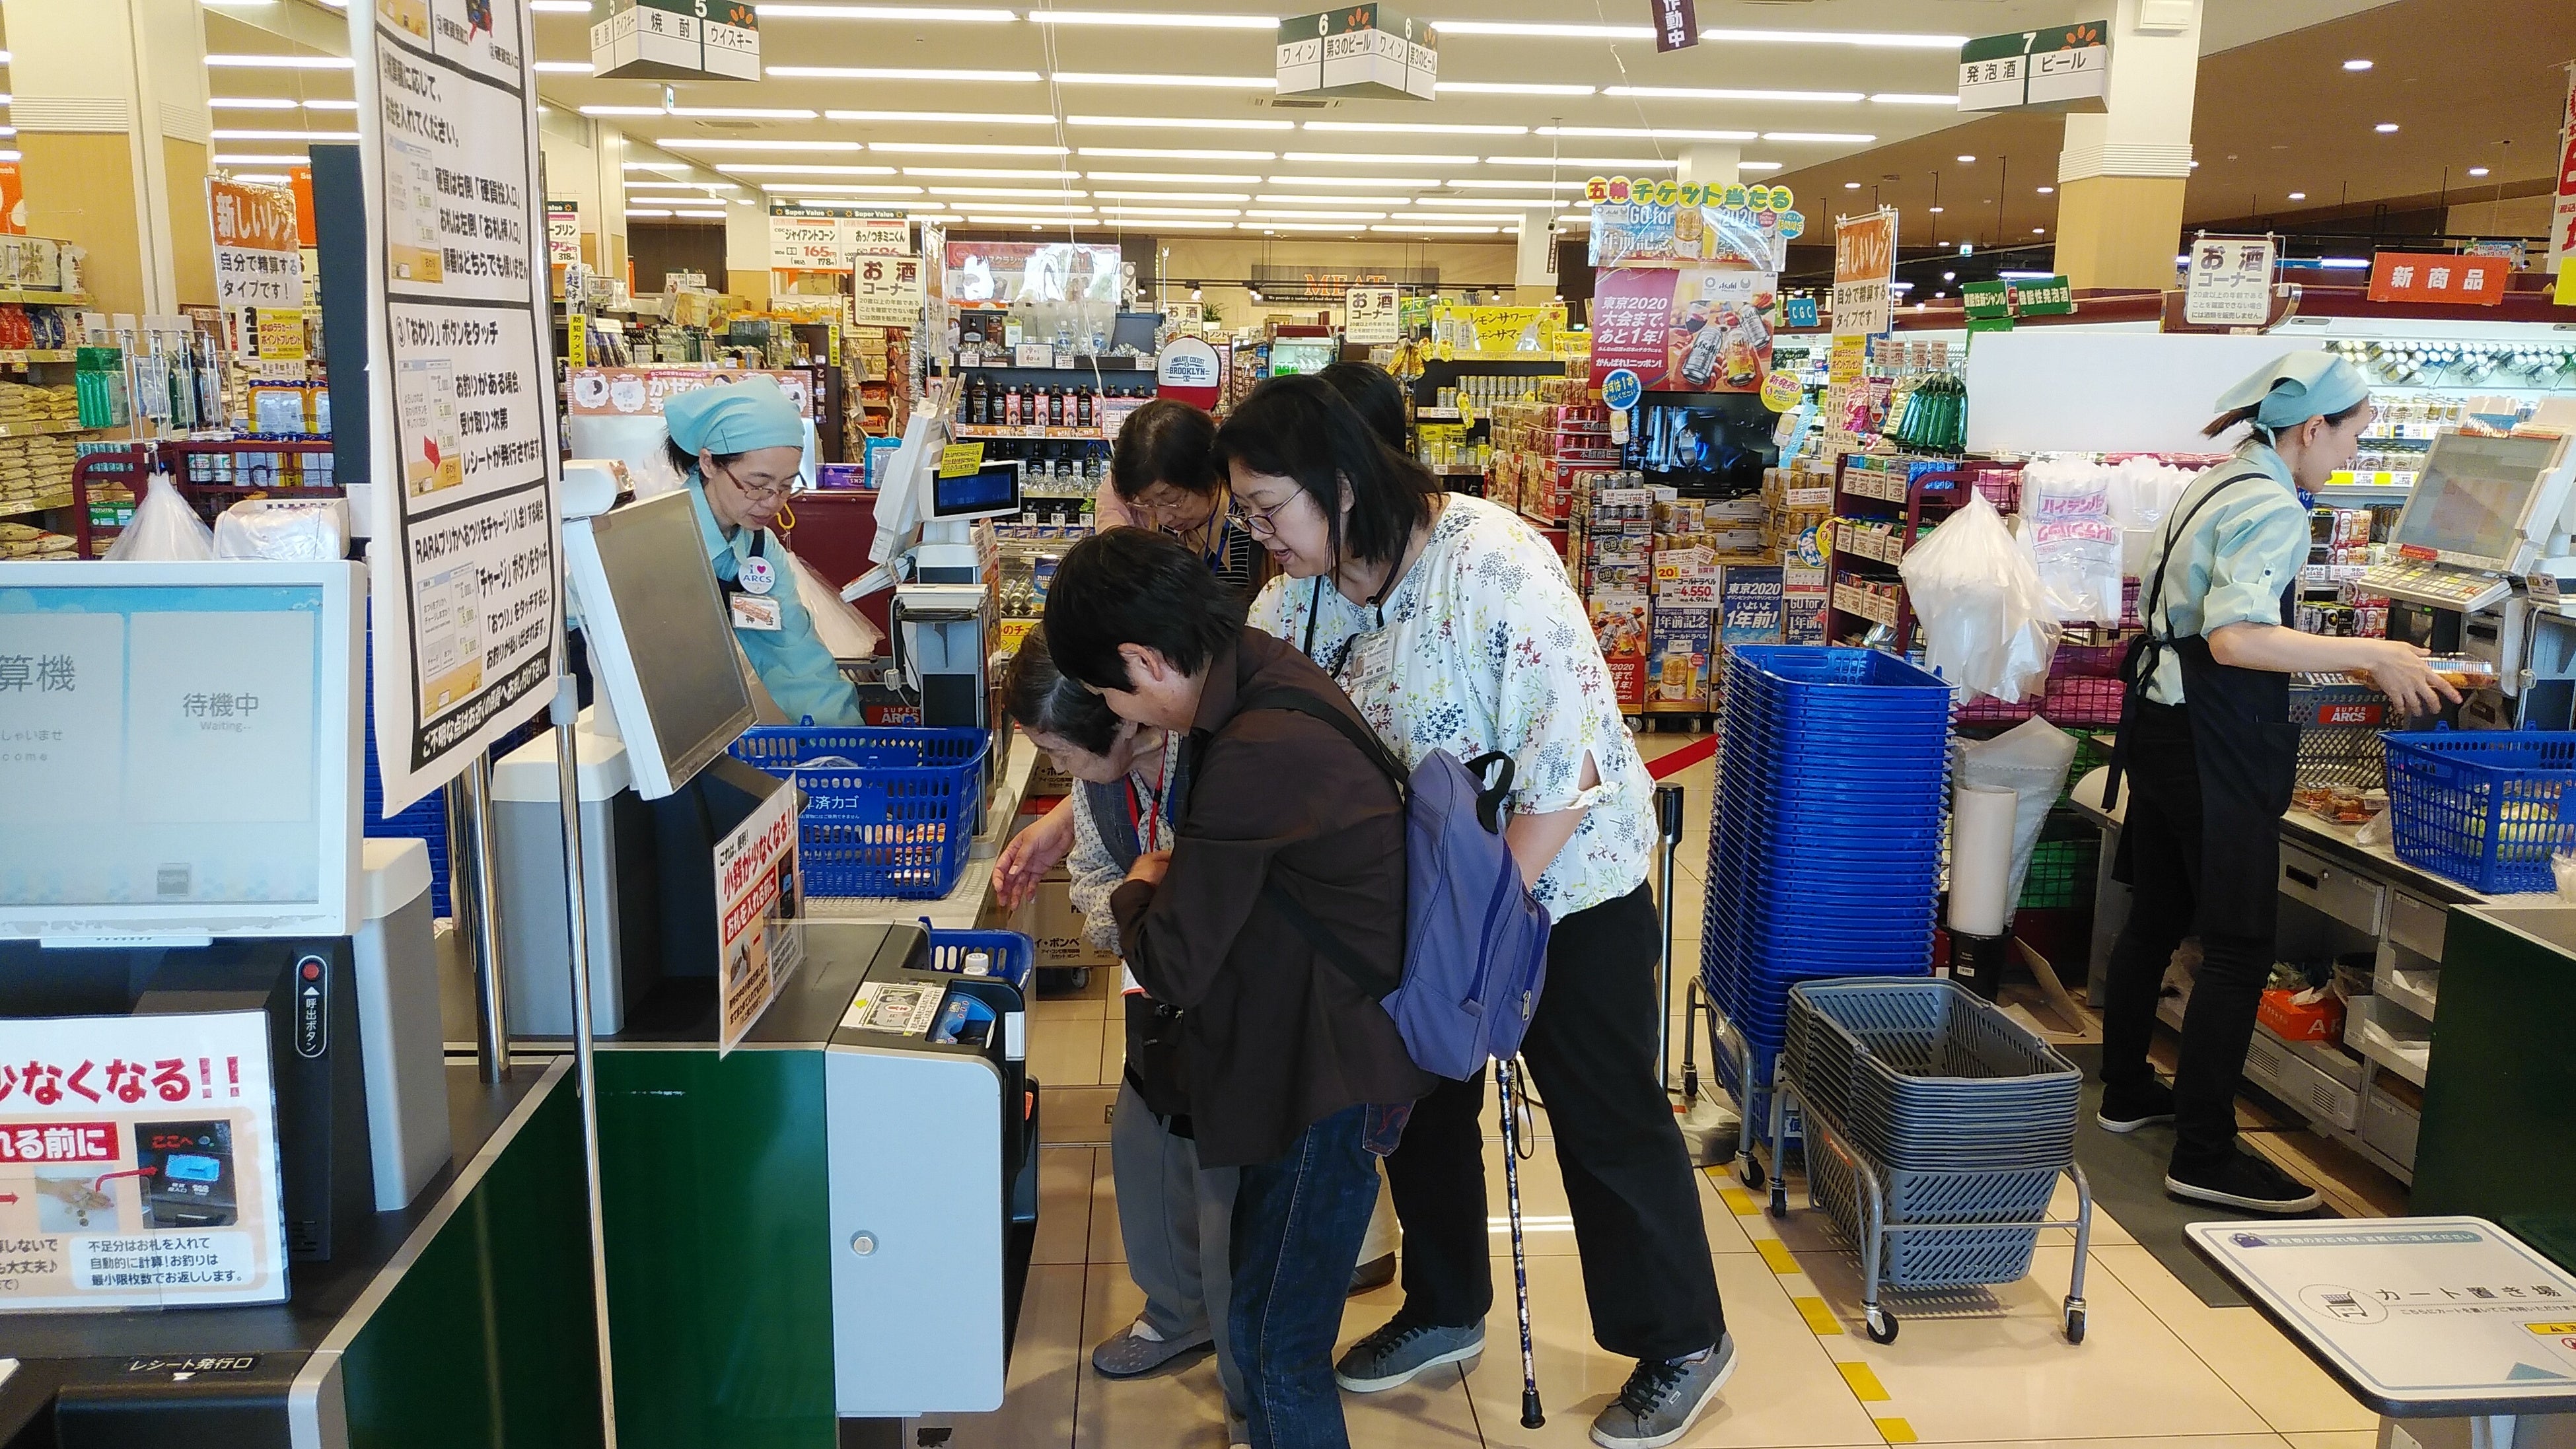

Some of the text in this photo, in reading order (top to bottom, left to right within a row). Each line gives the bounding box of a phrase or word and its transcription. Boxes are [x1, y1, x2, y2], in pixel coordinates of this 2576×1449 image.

[610, 0, 616, 15] 5
[695, 0, 707, 17] 5
[651, 12, 690, 38] 焼酎
[1318, 15, 1328, 36] 6
[1405, 18, 1412, 39] 6
[711, 26, 752, 48] ウイスキー
[1326, 33, 1371, 58] 第3のビール
[2022, 32, 2037, 53] 7
[1283, 44, 1316, 63] ワイン
[1379, 35, 1404, 59] ワイン
[1409, 46, 1436, 71] 第3のビール
[2042, 52, 2086, 73] ビール
[1966, 60, 2016, 83] 発泡酒
[1588, 182, 1789, 208] 五輪チケット当たる
[1629, 205, 1650, 225] GO
[1653, 205, 1675, 225] for
[785, 230, 836, 240] ジャイアントコーン
[1603, 232, 1674, 251] 年前記念
[221, 252, 298, 275] 自分で精算する
[2201, 246, 2265, 271] お酒
[863, 261, 917, 283] お酒
[2198, 271, 2262, 288] コーナー
[2391, 265, 2484, 291] 新商品
[863, 283, 917, 296] コーナー
[1837, 284, 1886, 305] 自分で精算する
[2019, 287, 2069, 305] 機能性発泡酒
[1352, 293, 1393, 309] お酒
[1602, 297, 1667, 310] 東京2020
[1964, 292, 2006, 307] 機能性新ジャンル
[1168, 306, 1198, 318] お酒
[1352, 309, 1393, 320] コーナー
[1470, 312, 1535, 325] レモンサワーで
[1599, 312, 1665, 328] 大会まで、
[1793, 306, 1812, 319] CGC
[1598, 328, 1663, 345] あと1年!
[455, 371, 522, 398] お釣りがある場合、
[650, 378, 707, 397] かぜの
[1769, 374, 1800, 392] 新発売!
[460, 407, 508, 437] 受け取り次第
[463, 437, 542, 476] レシートが発行されます。
[750, 565, 754, 574] I
[1727, 583, 1781, 595] 東京2020
[1737, 602, 1771, 610] いよいよ
[1790, 599, 1805, 609] GO
[1805, 599, 1820, 609] for
[1654, 616, 1709, 629] 1年前記念
[1727, 611, 1779, 629] 1年前!
[487, 617, 546, 670] お釣りが払い出されます。
[183, 693, 260, 717] 待機中
[881, 713, 919, 723] ARCS
[2330, 712, 2367, 723] ARCS
[727, 875, 776, 940] お札を入れる前に
[305, 997, 318, 1053] 呼出ボタン
[152, 1135, 194, 1149] ここへ
[88, 1237, 211, 1252] 不足分はお札を入れて
[92, 1270, 242, 1286] 最小限枚数でお返しします。
[2376, 1285, 2561, 1301] カート置き場
[129, 1357, 254, 1371] レシート発行口
